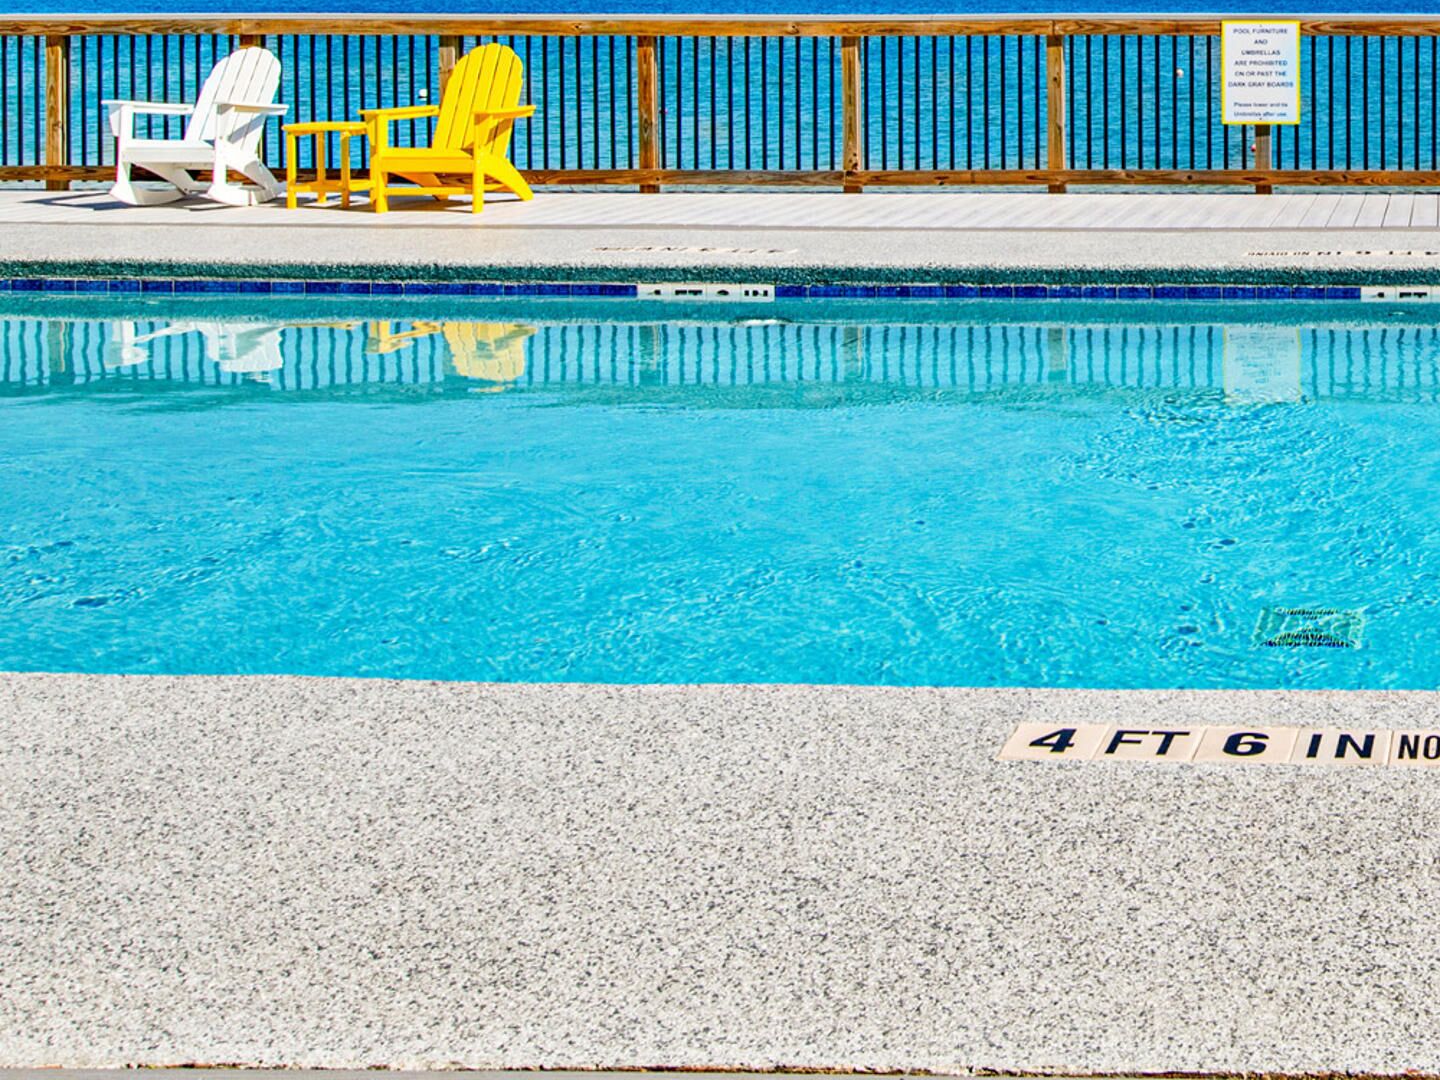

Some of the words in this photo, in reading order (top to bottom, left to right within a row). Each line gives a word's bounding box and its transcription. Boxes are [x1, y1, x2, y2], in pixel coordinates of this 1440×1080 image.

[1029, 728, 1077, 753] 4
[1103, 730, 1190, 755] FT
[1222, 732, 1270, 756] 6
[1305, 733, 1376, 759] IN
